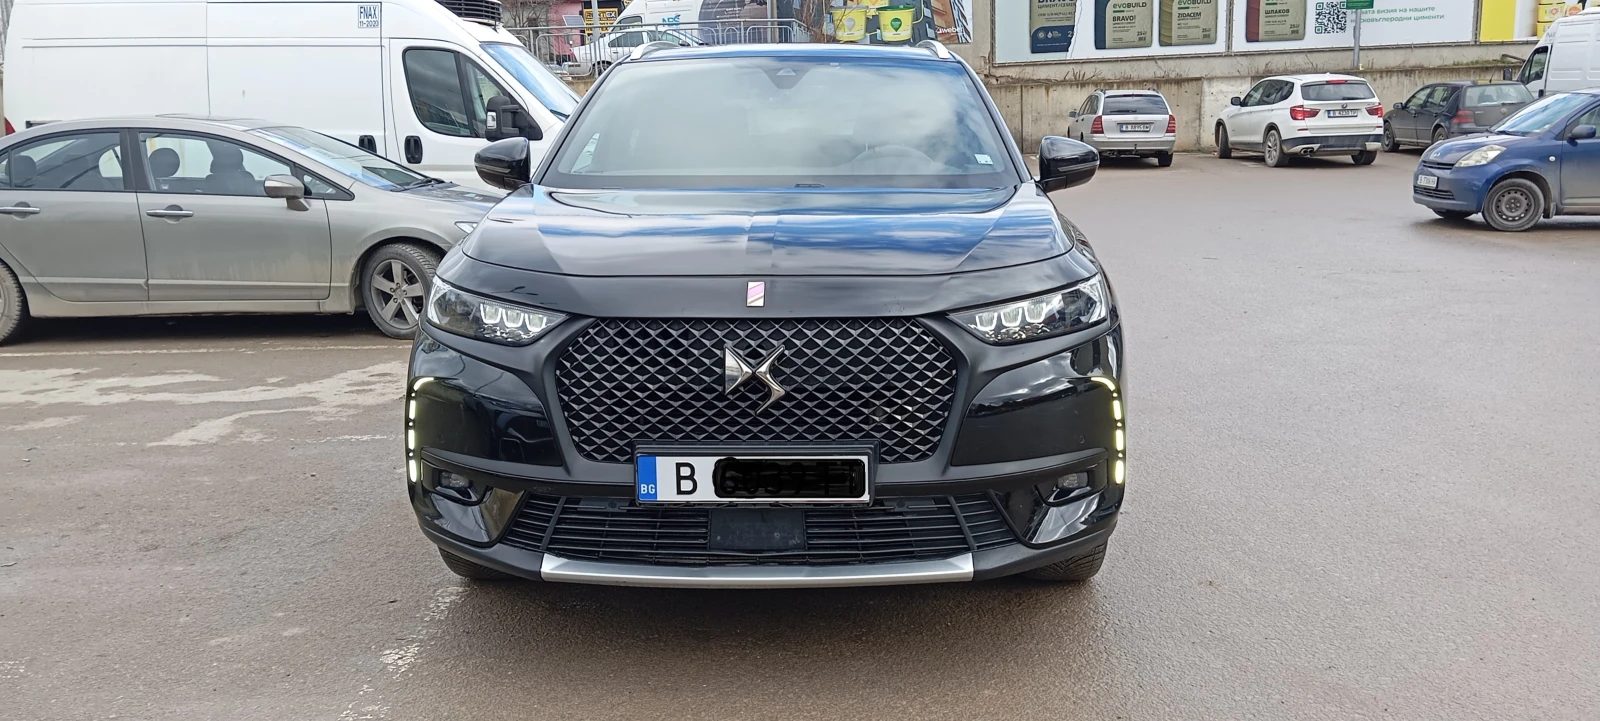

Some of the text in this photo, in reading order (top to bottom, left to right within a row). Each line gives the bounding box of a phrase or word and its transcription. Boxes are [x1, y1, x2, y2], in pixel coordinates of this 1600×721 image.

[360, 6, 378, 20] FNAX
[675, 461, 698, 496] B
[640, 484, 656, 494] BG
